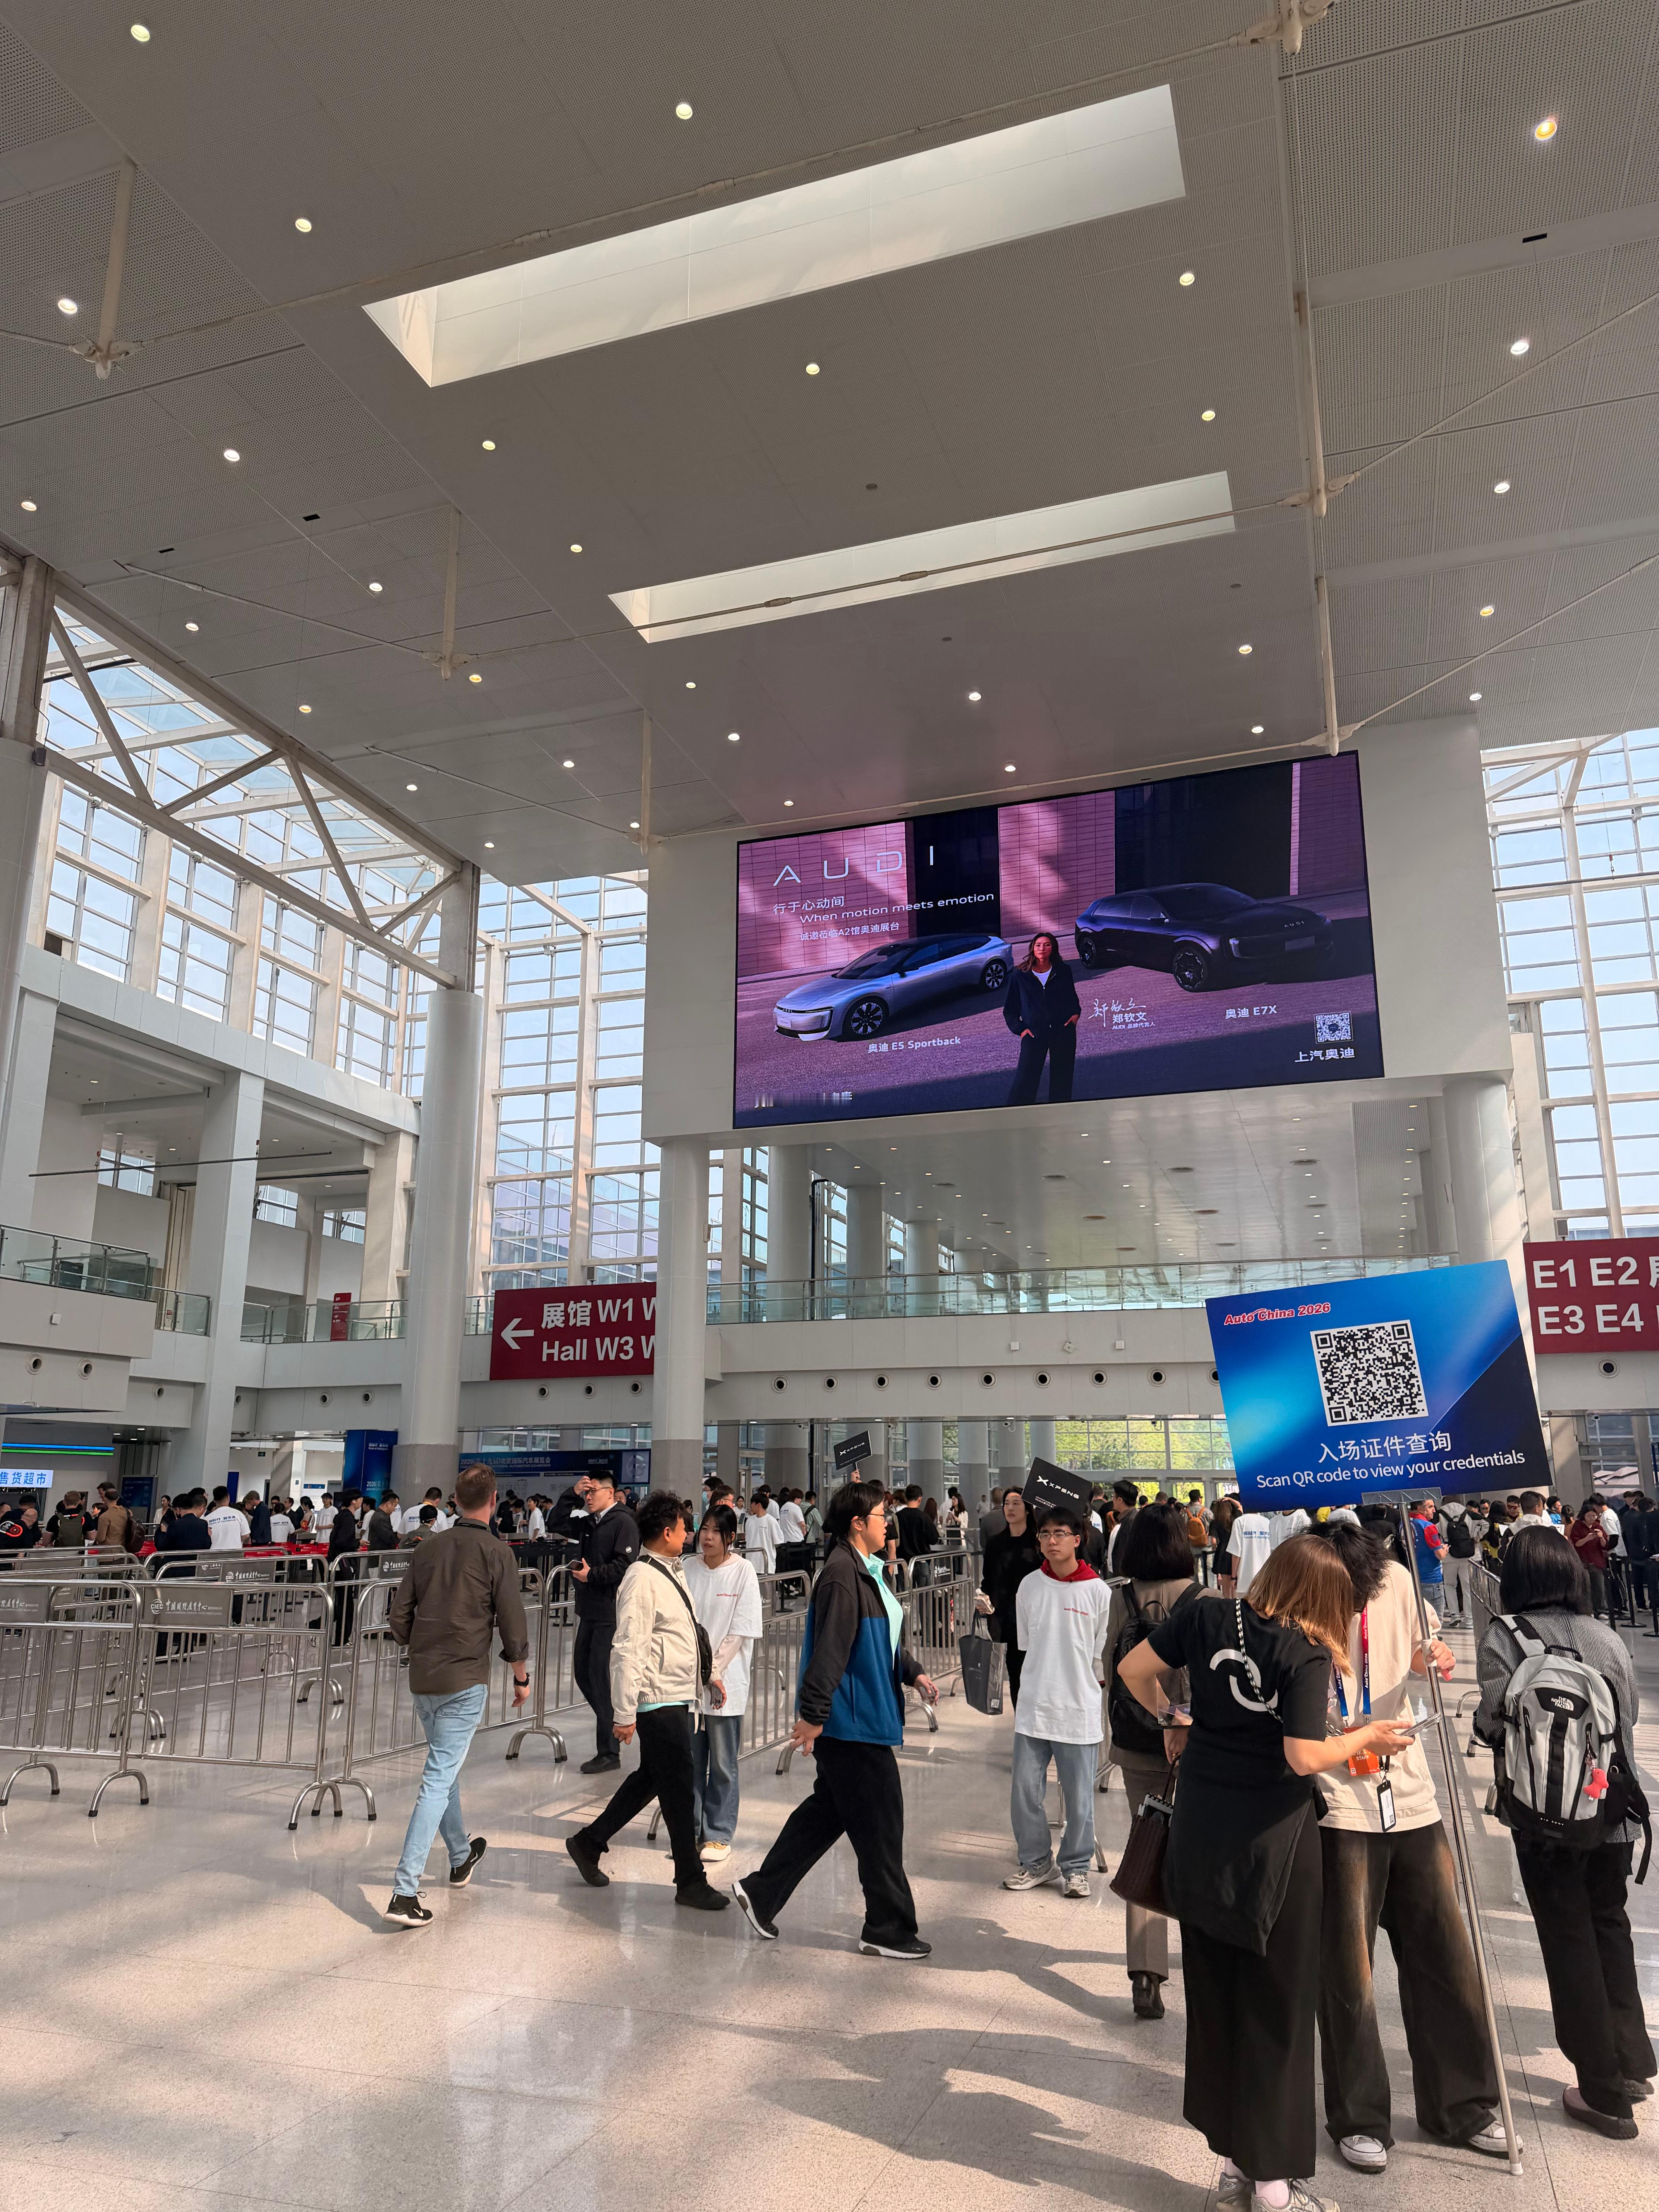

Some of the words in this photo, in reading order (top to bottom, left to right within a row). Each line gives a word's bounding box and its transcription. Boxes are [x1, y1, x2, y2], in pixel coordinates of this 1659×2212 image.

[773, 846, 934, 886] AUDI
[773, 896, 845, 915] 行于心动间
[800, 913, 837, 923] When
[842, 905, 888, 919] motion
[892, 900, 933, 913] meets
[938, 893, 994, 907] emotion
[1112, 1011, 1147, 1024] 郑钦文
[1225, 1007, 1249, 1019] 奥迪
[1254, 1005, 1277, 1015] E7X
[868, 1042, 888, 1053] 奥迪
[892, 1041, 904, 1051] E5
[908, 1036, 961, 1050] Sportback
[1295, 1047, 1355, 1063] 上汽奥迪
[1533, 1259, 1577, 1288] E1
[1590, 1256, 1639, 1286] E2
[541, 1300, 592, 1329] 展馆
[598, 1298, 633, 1322] W1
[1224, 1312, 1255, 1325] Auto
[1257, 1309, 1295, 1321] China
[1298, 1302, 1331, 1316] 2026
[1538, 1305, 1585, 1334] E3
[1595, 1303, 1644, 1333] E4
[542, 1339, 587, 1362] Hall
[595, 1336, 634, 1361] W3
[1318, 1431, 1451, 1463] 入场证件查询
[0, 1472, 46, 1485] 售货超市
[1257, 1475, 1290, 1488] Scan
[1293, 1471, 1315, 1487] QR
[1317, 1467, 1351, 1482] code
[1353, 1467, 1368, 1479] to
[1370, 1463, 1404, 1477] view
[1407, 1461, 1440, 1478] your
[1443, 1450, 1525, 1471] credentials
[1049, 1482, 1080, 1499] XPENG
